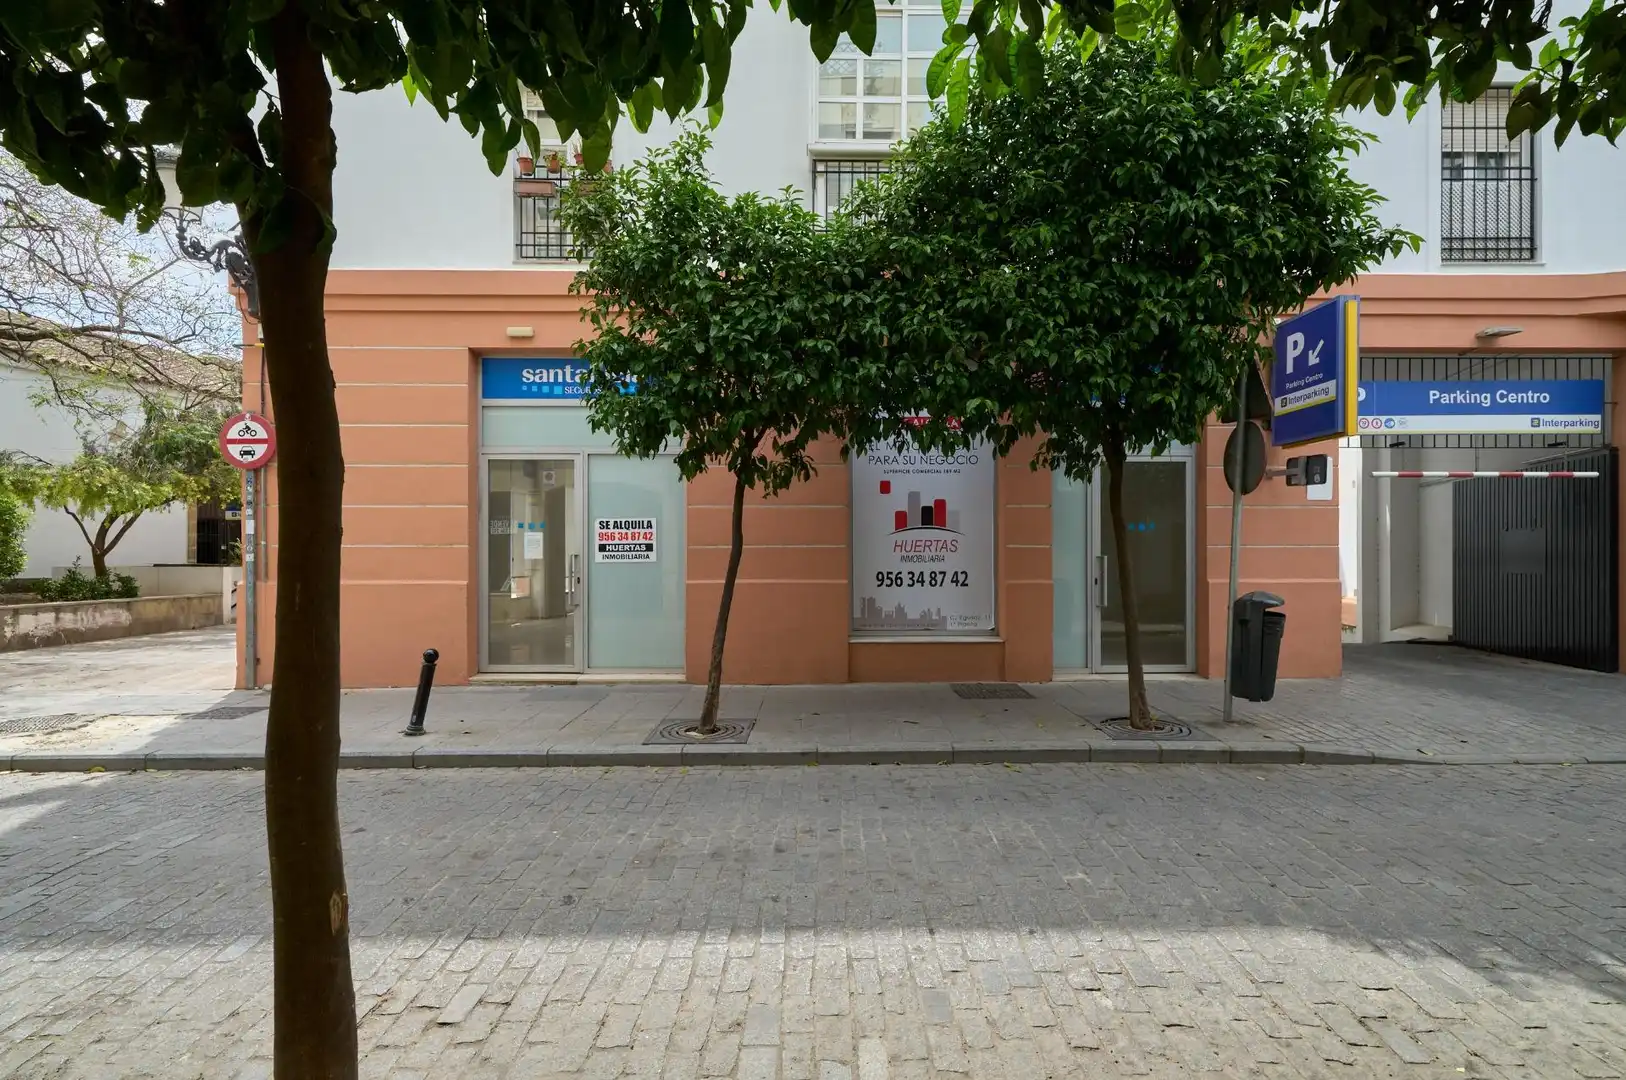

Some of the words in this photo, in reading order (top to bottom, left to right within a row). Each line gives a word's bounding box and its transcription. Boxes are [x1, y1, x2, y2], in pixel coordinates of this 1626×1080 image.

[1286, 331, 1305, 375] P
[1286, 379, 1305, 389] Parking
[1305, 373, 1323, 383] Centro
[1288, 387, 1329, 404] Interparking
[1429, 390, 1491, 407] Parking
[1496, 390, 1550, 404] Centro
[1541, 418, 1600, 429] Interparking
[868, 455, 900, 465] PARA
[903, 455, 917, 465] SU
[920, 454, 979, 465] NEGOCIO
[599, 520, 612, 530] SE
[612, 520, 653, 531] ALQUILA
[598, 531, 616, 541] 956
[617, 531, 629, 541] 34
[630, 531, 641, 541] 87
[642, 531, 654, 541] 42
[893, 539, 959, 553] HUERTAS
[900, 555, 946, 563] INMOBILIARIA
[876, 571, 904, 588] 956
[907, 571, 925, 588] 34
[929, 571, 947, 588] 87
[951, 571, 969, 588] 42
